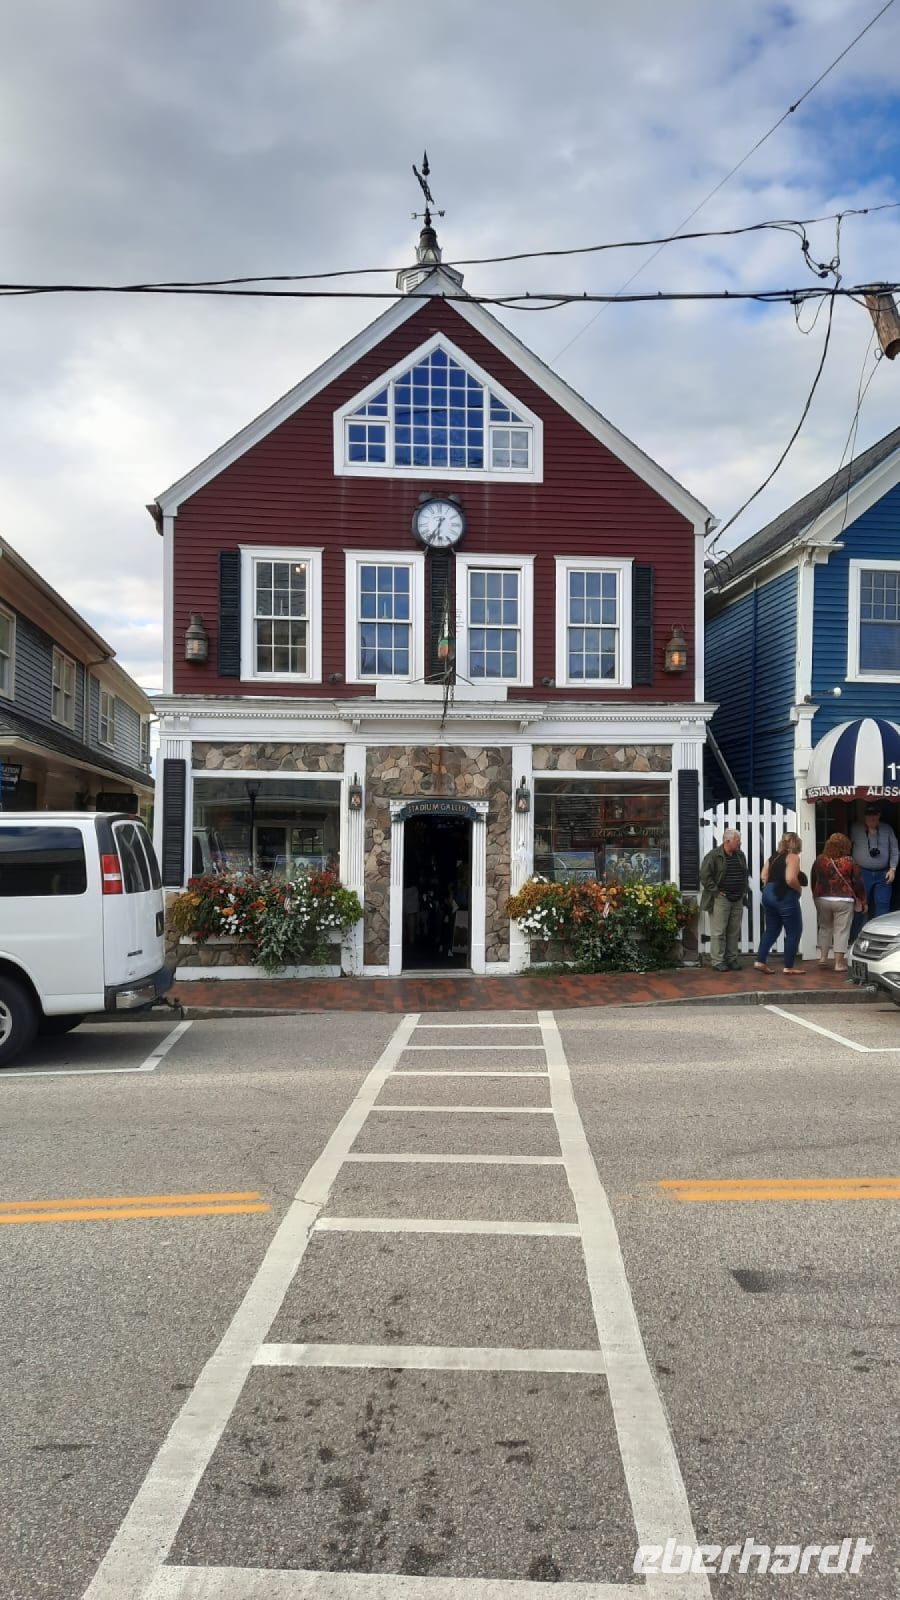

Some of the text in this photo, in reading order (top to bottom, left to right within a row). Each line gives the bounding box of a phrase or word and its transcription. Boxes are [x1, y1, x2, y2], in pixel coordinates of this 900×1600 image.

[887, 762, 900, 781] 1
[807, 785, 900, 799] RESTAURANT ALISS
[408, 803, 469, 814] STADIUM GALLERY
